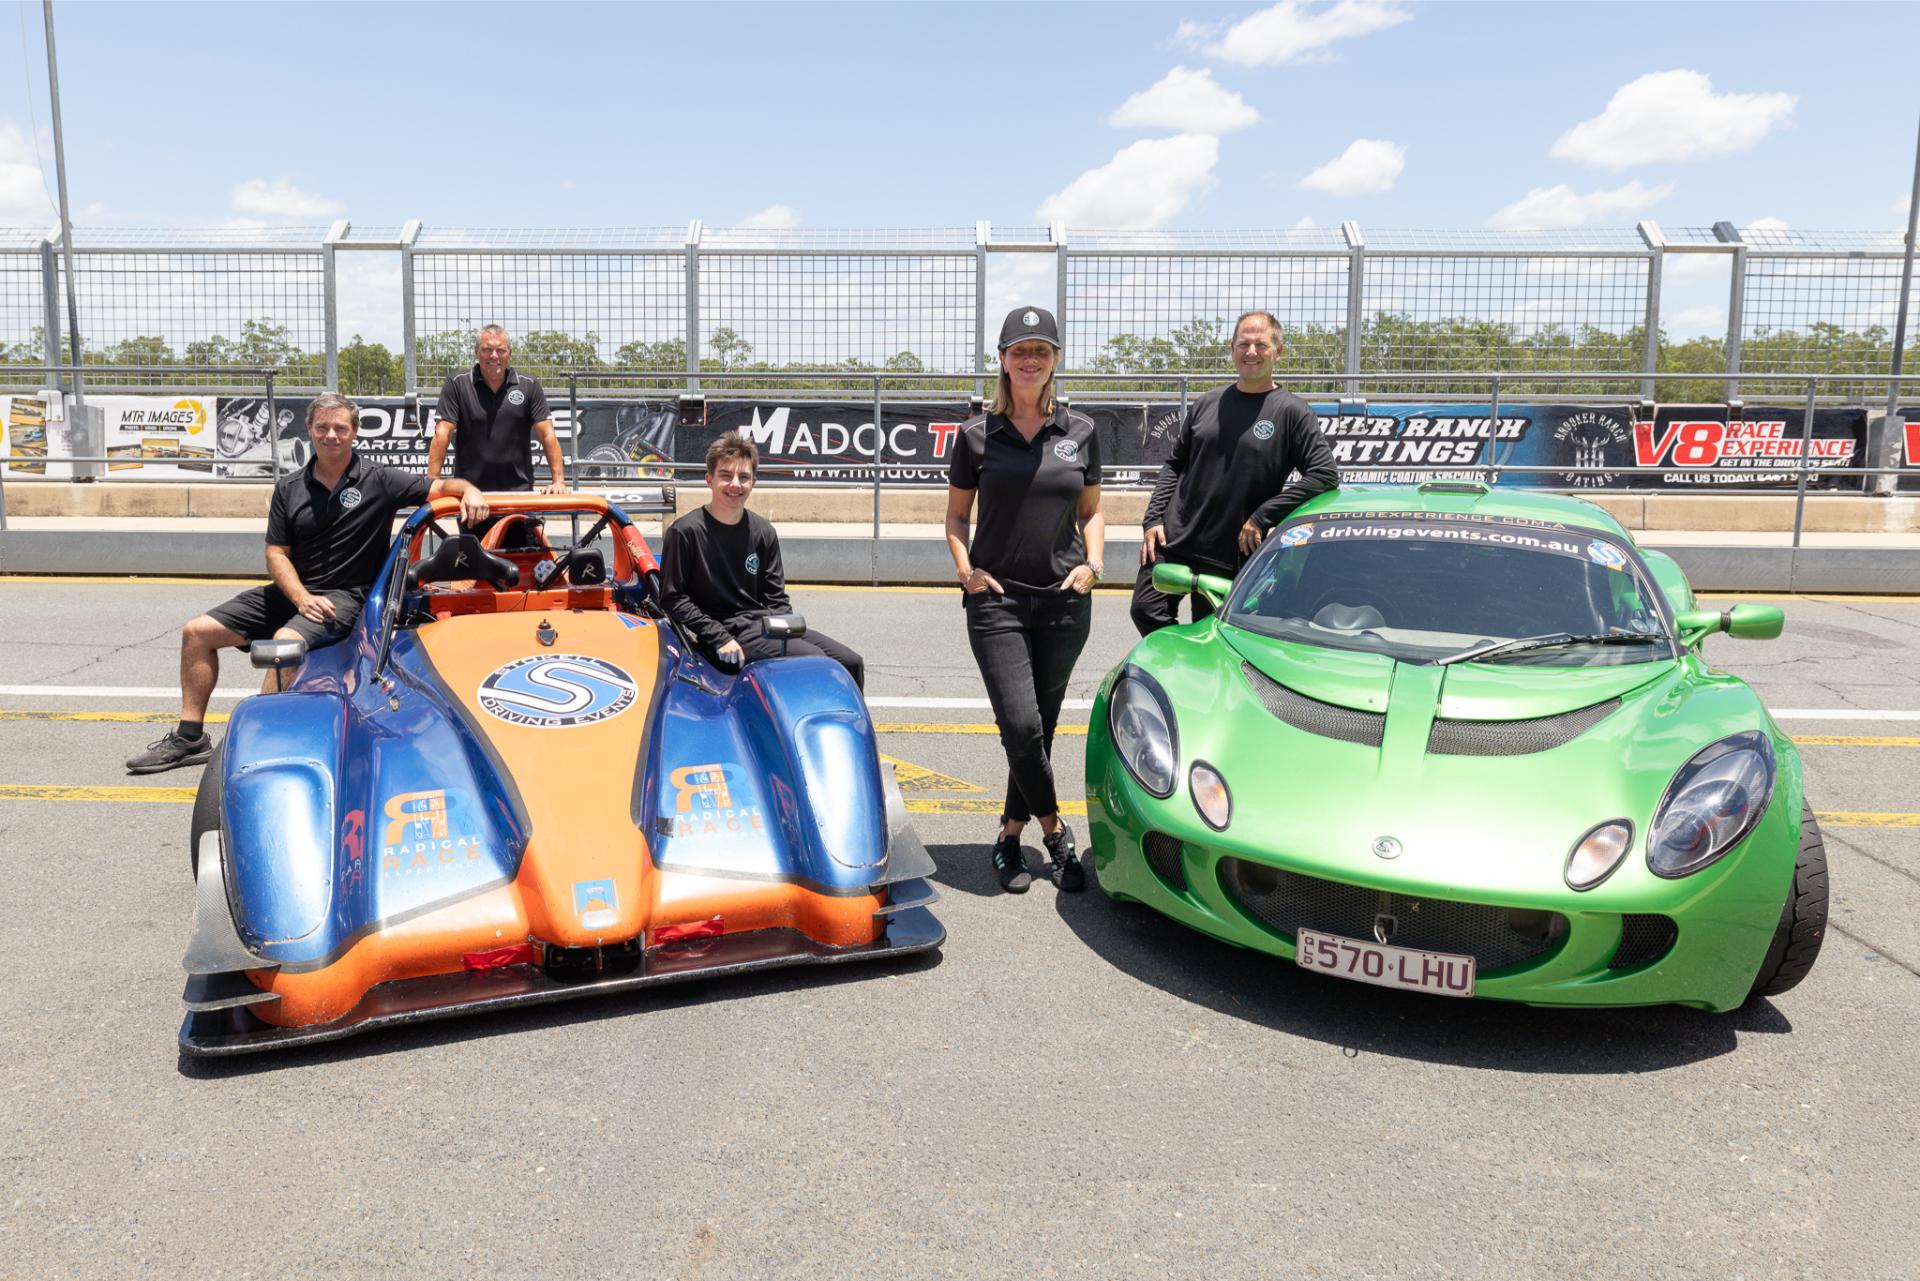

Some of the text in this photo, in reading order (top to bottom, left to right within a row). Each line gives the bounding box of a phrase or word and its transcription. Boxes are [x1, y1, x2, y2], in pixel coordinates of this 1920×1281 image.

[121, 410, 194, 423] MTR IMAGES
[1151, 411, 1181, 439] BROOK
[1554, 412, 1628, 443] BROOKER RANCH
[739, 406, 917, 456] MADOC
[1402, 418, 1525, 438] RANCH
[1724, 421, 1785, 439] RACE
[1333, 440, 1479, 463] ATINGS
[1633, 421, 1726, 467] V8
[1719, 439, 1856, 457] EXPERINCE
[1720, 459, 1738, 467] GET
[1739, 459, 1751, 467] IN
[1753, 459, 1772, 467] THE
[1342, 471, 1388, 483] CERAMIC
[1389, 471, 1433, 483] COATING
[1435, 471, 1499, 483] SPECIALISS
[1558, 472, 1621, 488] OATING
[1663, 473, 1693, 483] CALL
[1694, 473, 1711, 483] US
[1320, 526, 1579, 554] drivingevents.com.au
[484, 688, 635, 726] DRIVING EVENTS
[676, 807, 761, 826] RADICAL
[678, 815, 769, 838] RACE
[383, 835, 480, 856] RADICAL
[383, 844, 480, 873] RACE
[1317, 940, 1469, 991] 570 LHU
